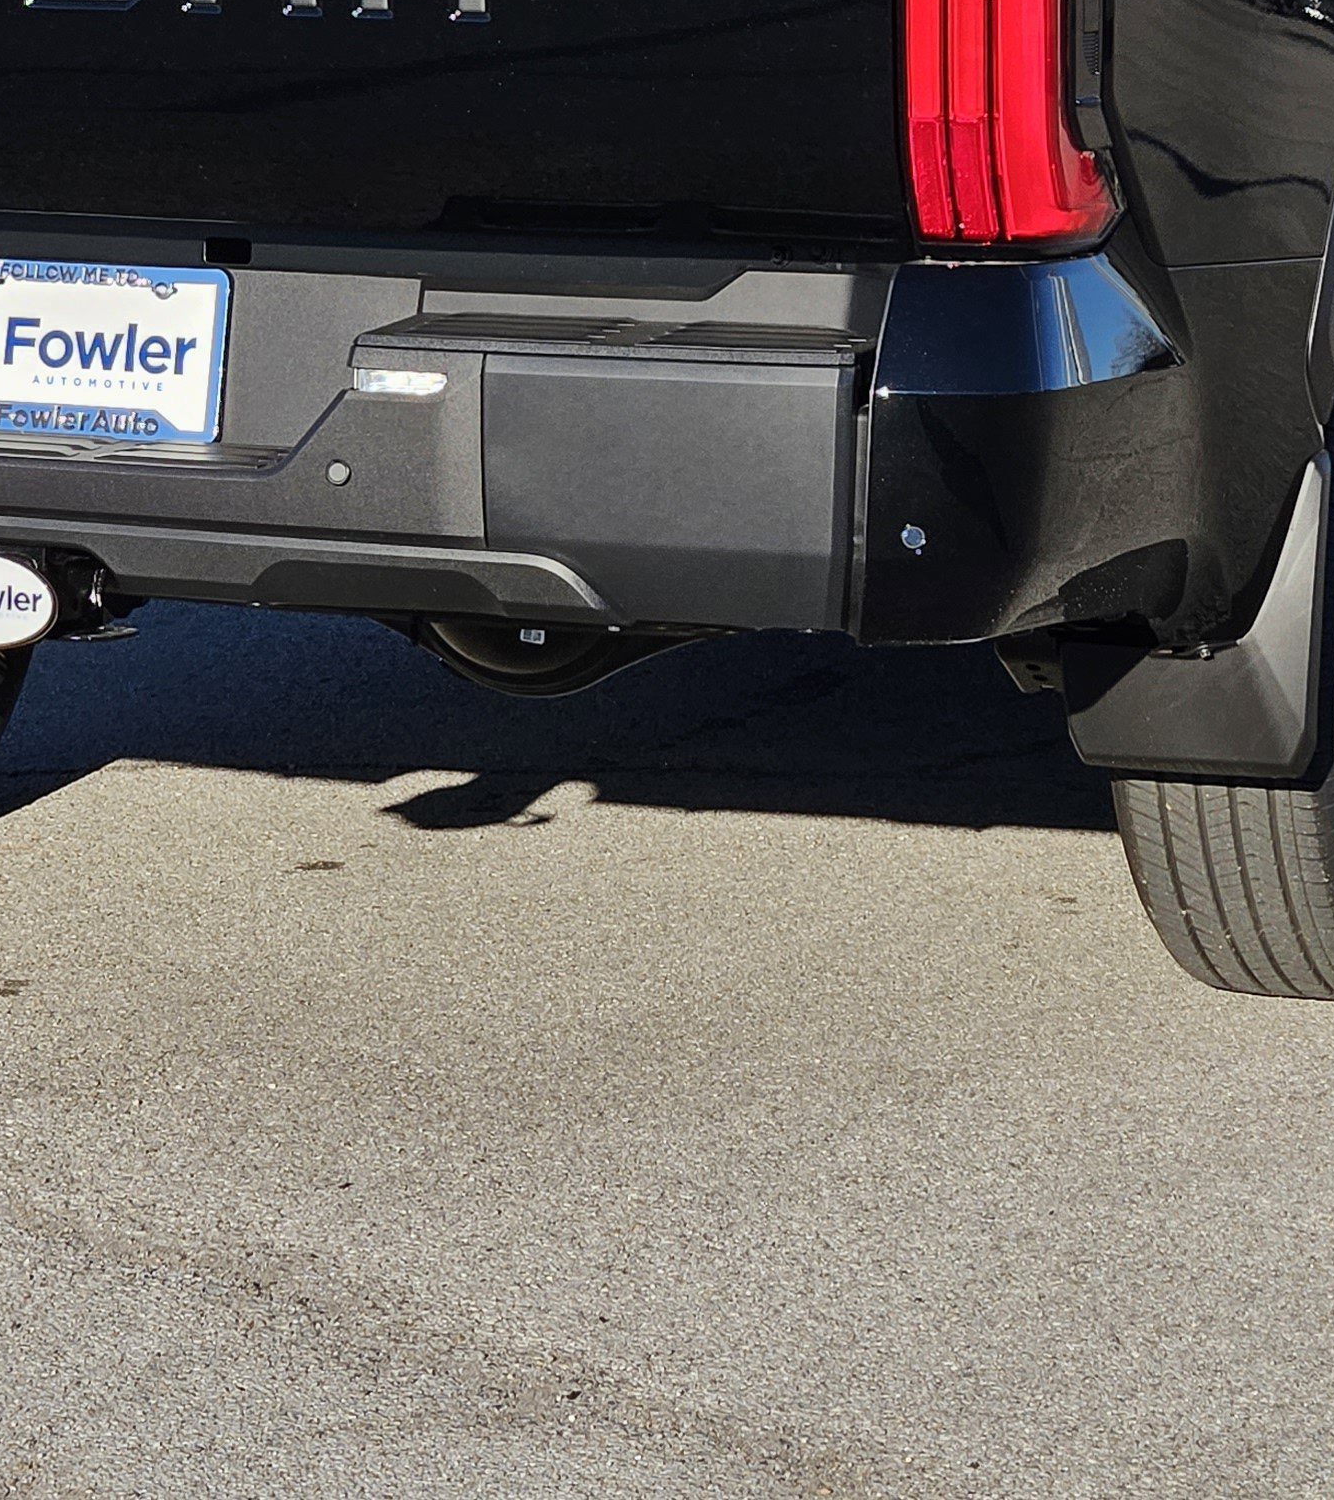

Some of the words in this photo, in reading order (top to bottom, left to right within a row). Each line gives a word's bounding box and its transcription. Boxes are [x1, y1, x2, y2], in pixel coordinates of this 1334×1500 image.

[0, 262, 79, 284] FOLLOW
[81, 266, 113, 286] ME
[3, 316, 197, 375] Fowler
[32, 375, 164, 392] AUTOMOTIVE
